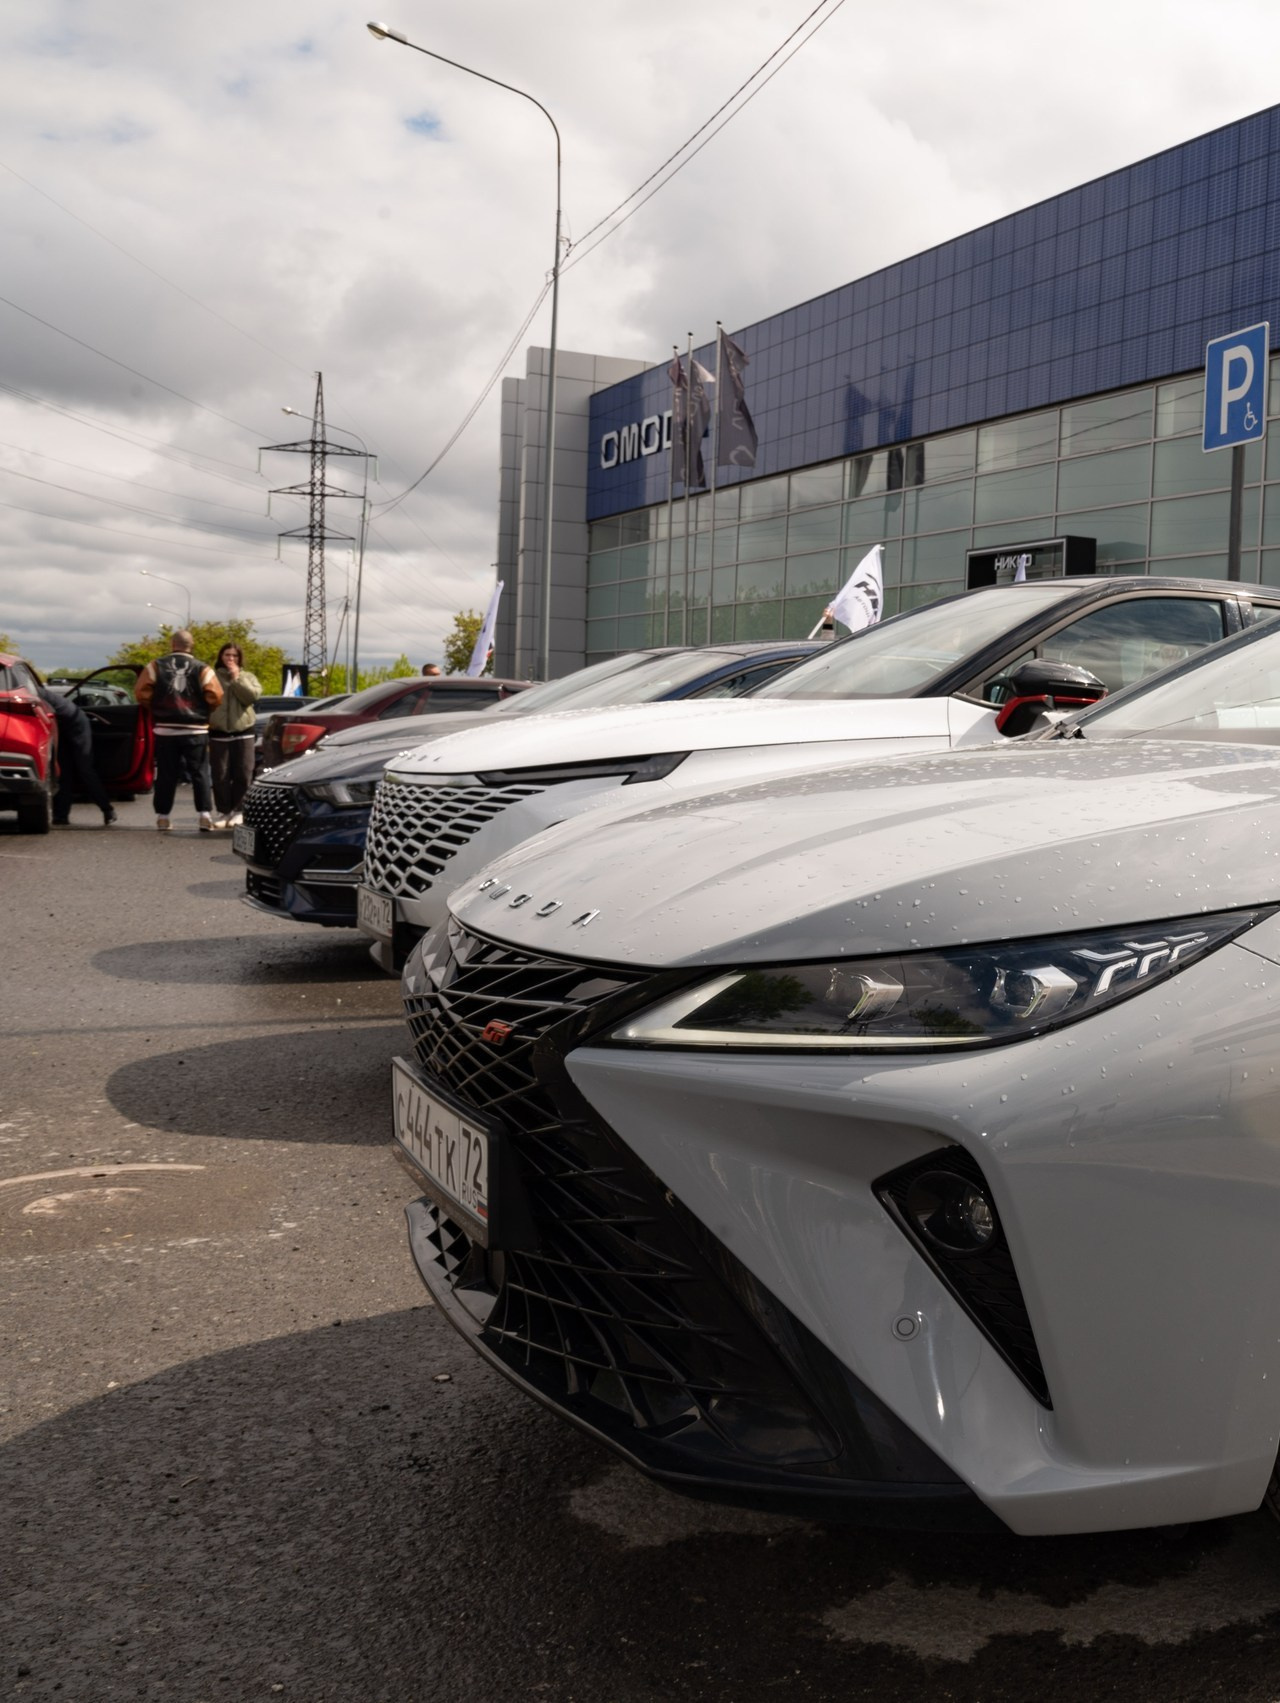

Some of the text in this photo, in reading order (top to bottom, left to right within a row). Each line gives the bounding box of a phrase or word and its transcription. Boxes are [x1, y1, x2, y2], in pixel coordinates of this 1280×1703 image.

[1220, 344, 1254, 435] P
[462, 1127, 483, 1192] 72
[462, 1181, 478, 1208] RUS
